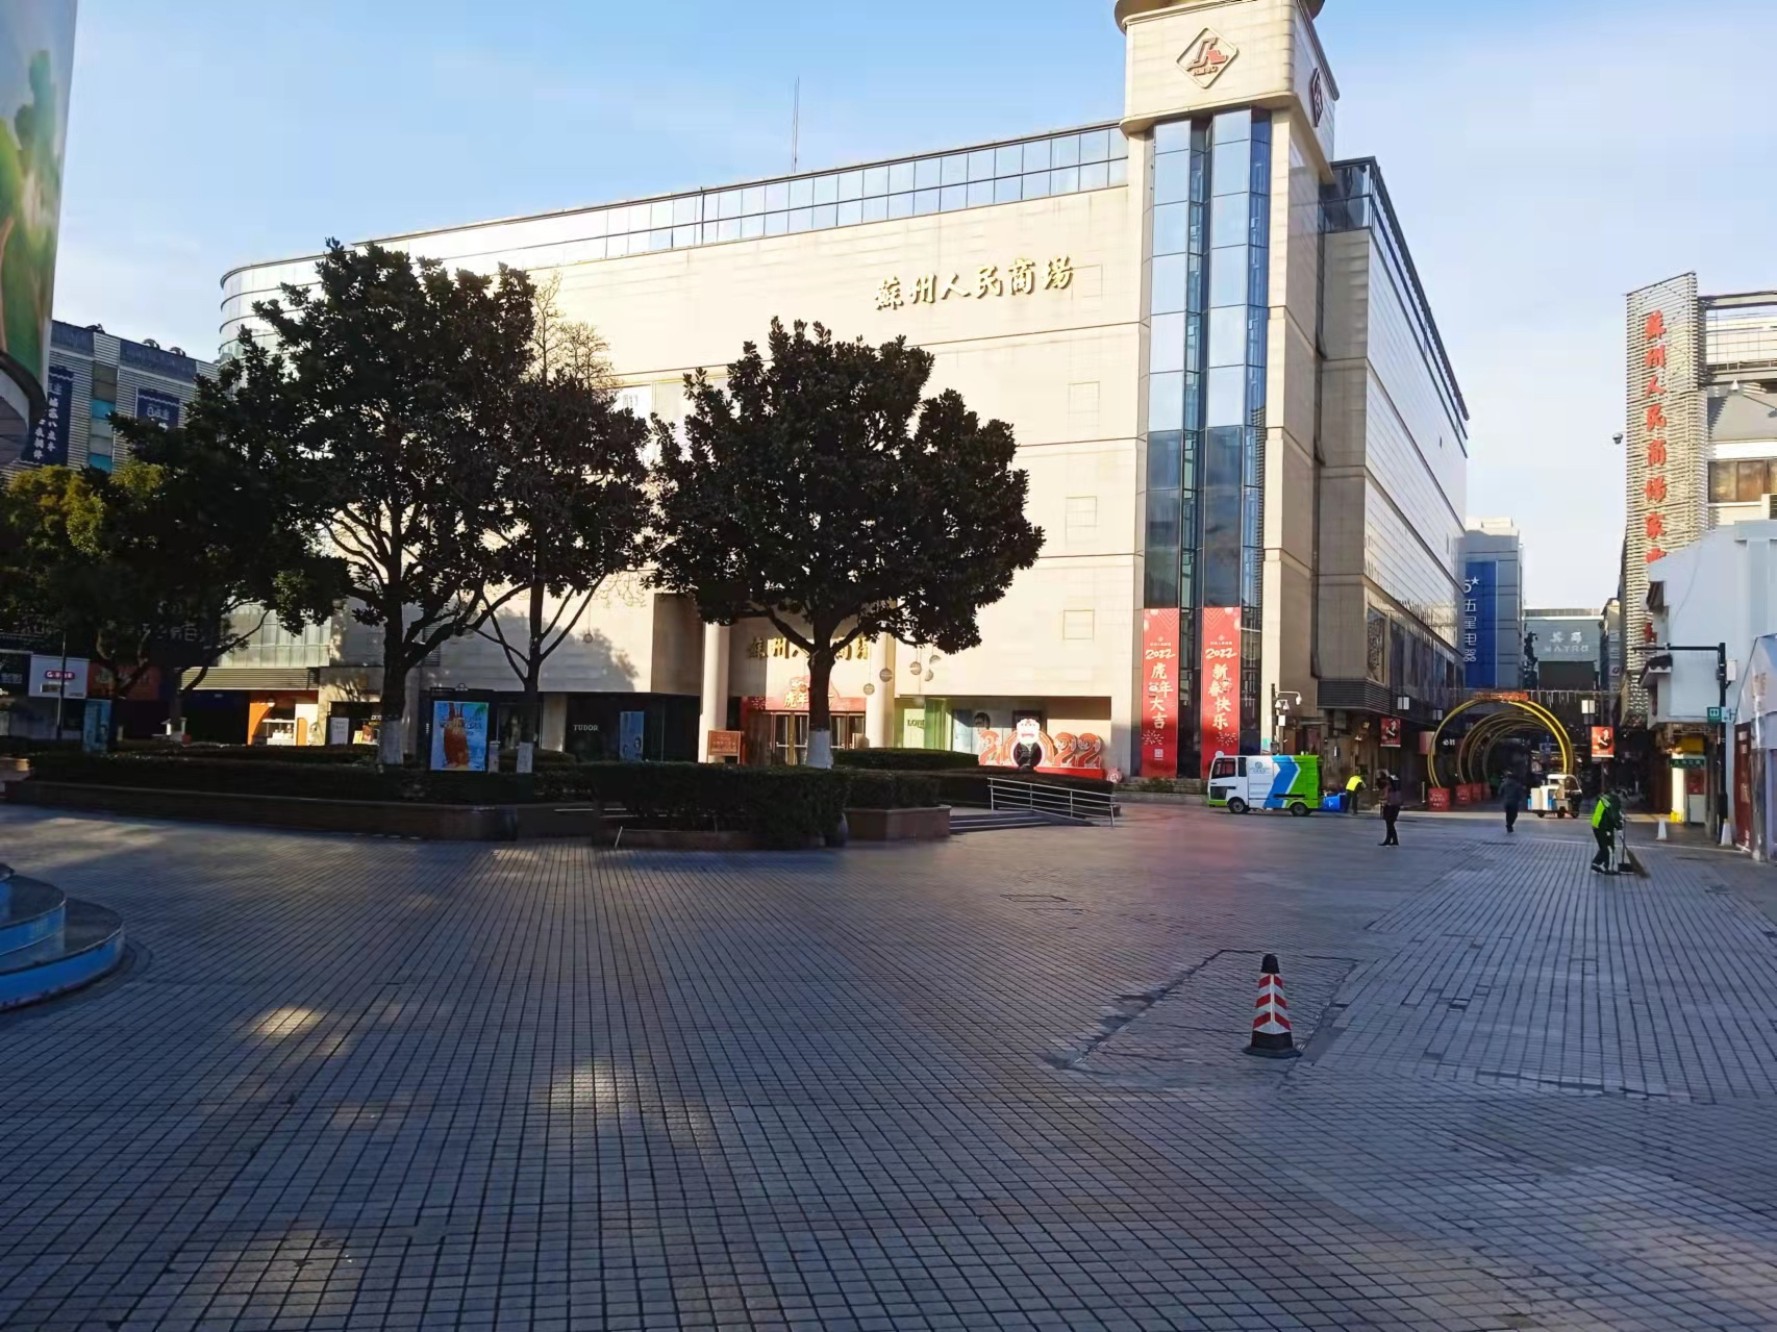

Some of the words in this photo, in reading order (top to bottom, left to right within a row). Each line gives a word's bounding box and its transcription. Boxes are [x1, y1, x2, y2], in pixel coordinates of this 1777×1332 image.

[1145, 648, 1176, 660] 2022
[1205, 647, 1237, 660] 2022
[1464, 598, 1477, 662] 五星电器
[1149, 662, 1173, 729] 虎年大吉
[1208, 663, 1232, 730] 新春快乐
